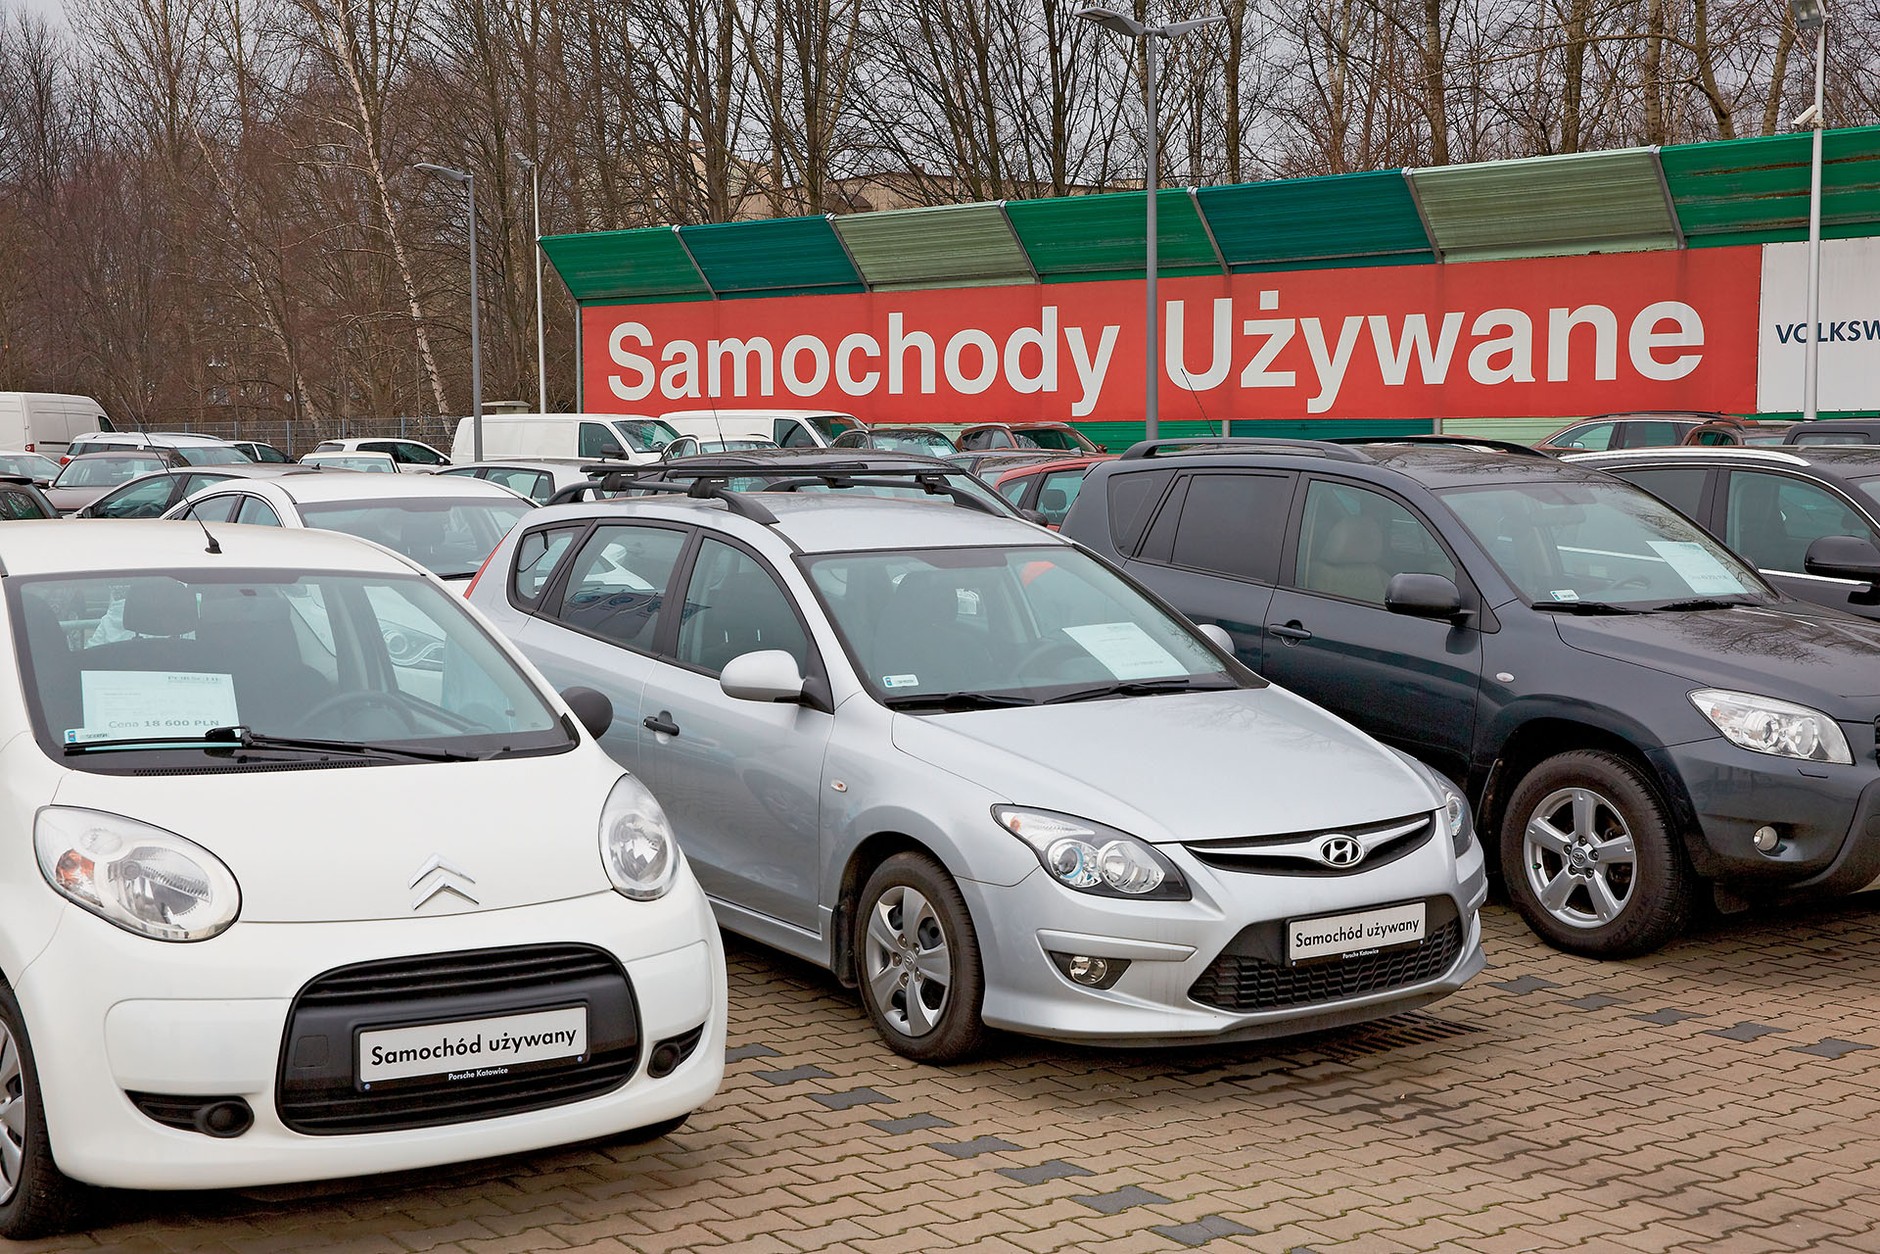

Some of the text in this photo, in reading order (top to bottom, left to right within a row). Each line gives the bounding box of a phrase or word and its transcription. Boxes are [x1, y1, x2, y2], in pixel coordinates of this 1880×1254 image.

[607, 290, 1706, 418] Samochody Używane
[144, 719, 160, 728] 18
[164, 718, 190, 727] 600
[194, 718, 220, 727] PLN
[1295, 919, 1420, 948] Samochód używany
[371, 1029, 577, 1066] Samochód używany
[448, 1067, 509, 1081] Porsche Katowice
